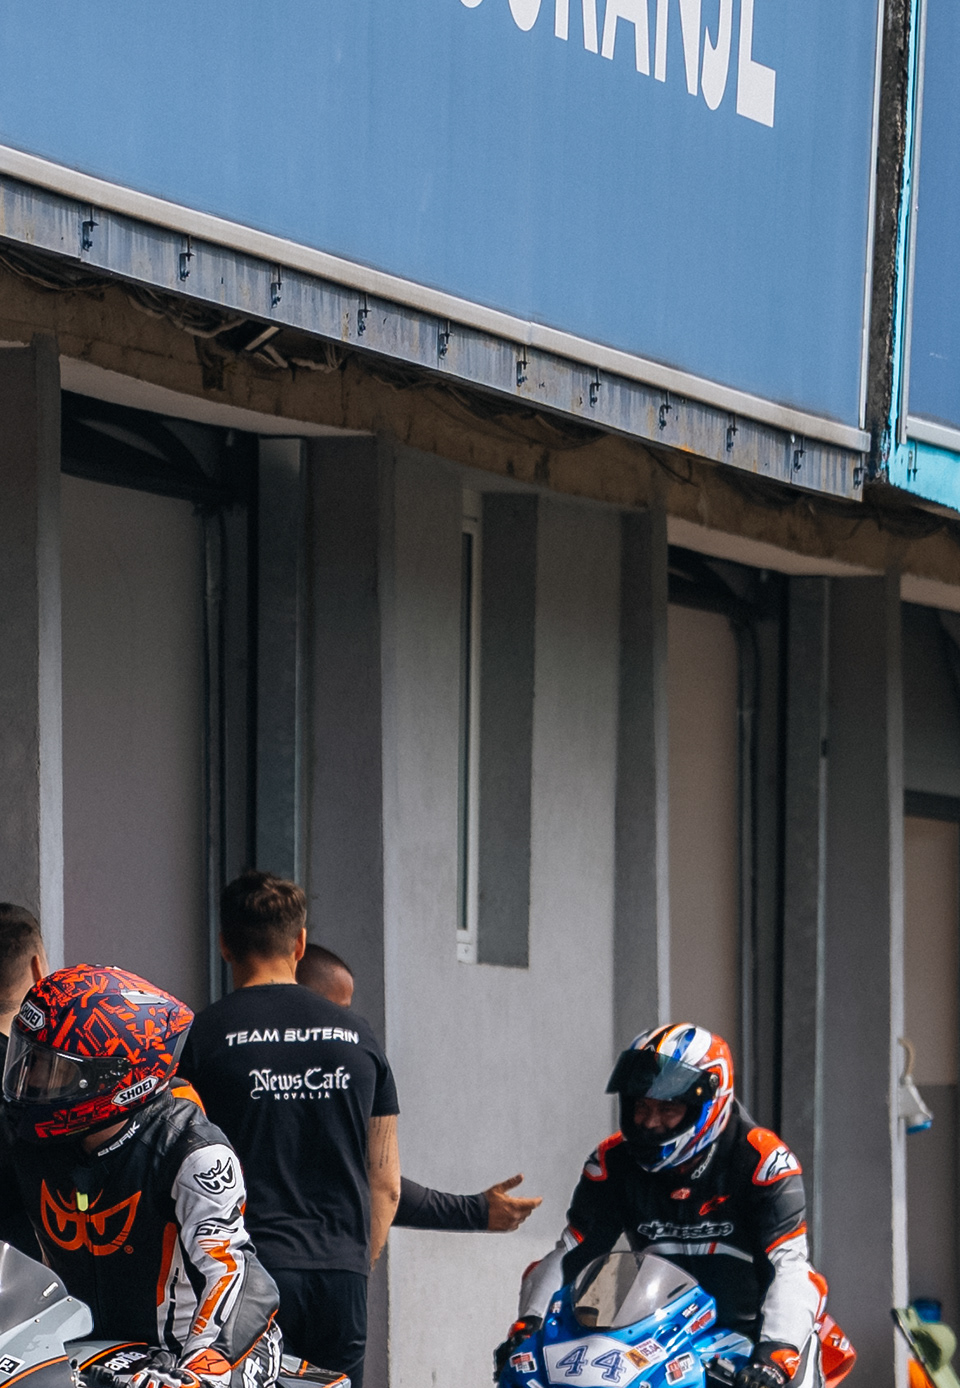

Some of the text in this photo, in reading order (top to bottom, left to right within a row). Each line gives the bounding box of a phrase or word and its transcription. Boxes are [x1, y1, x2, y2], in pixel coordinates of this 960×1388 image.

[225, 1027, 359, 1046] TEAM BUTERIN
[118, 1078, 154, 1103] SHOEI
[248, 1065, 351, 1100] News Cafe
[273, 1091, 331, 1100] NOVALJA
[555, 1345, 627, 1384] 44
